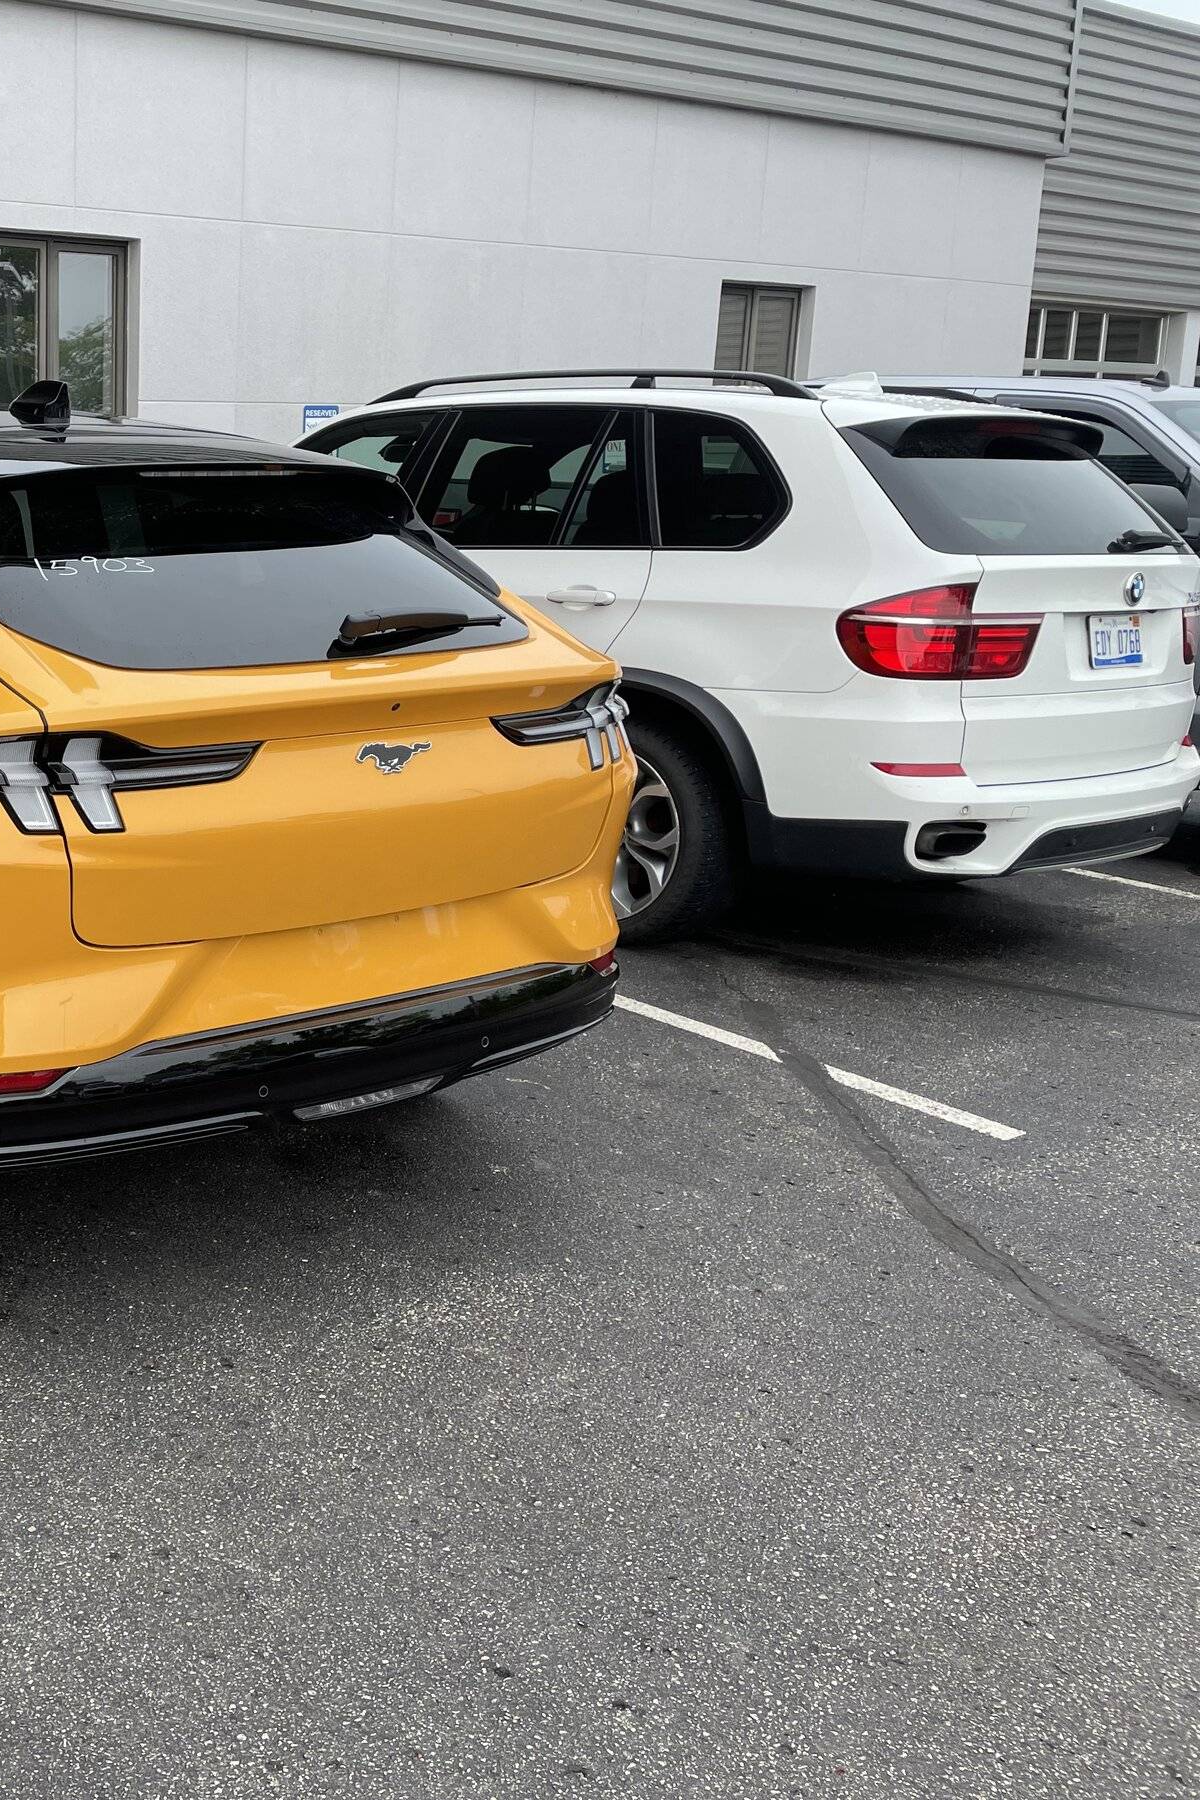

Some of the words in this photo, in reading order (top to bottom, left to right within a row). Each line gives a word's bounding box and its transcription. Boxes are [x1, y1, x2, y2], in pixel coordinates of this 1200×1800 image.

[305, 409, 337, 417] RESERVED
[33, 555, 155, 582] 15903
[1094, 630, 1112, 657] EDY
